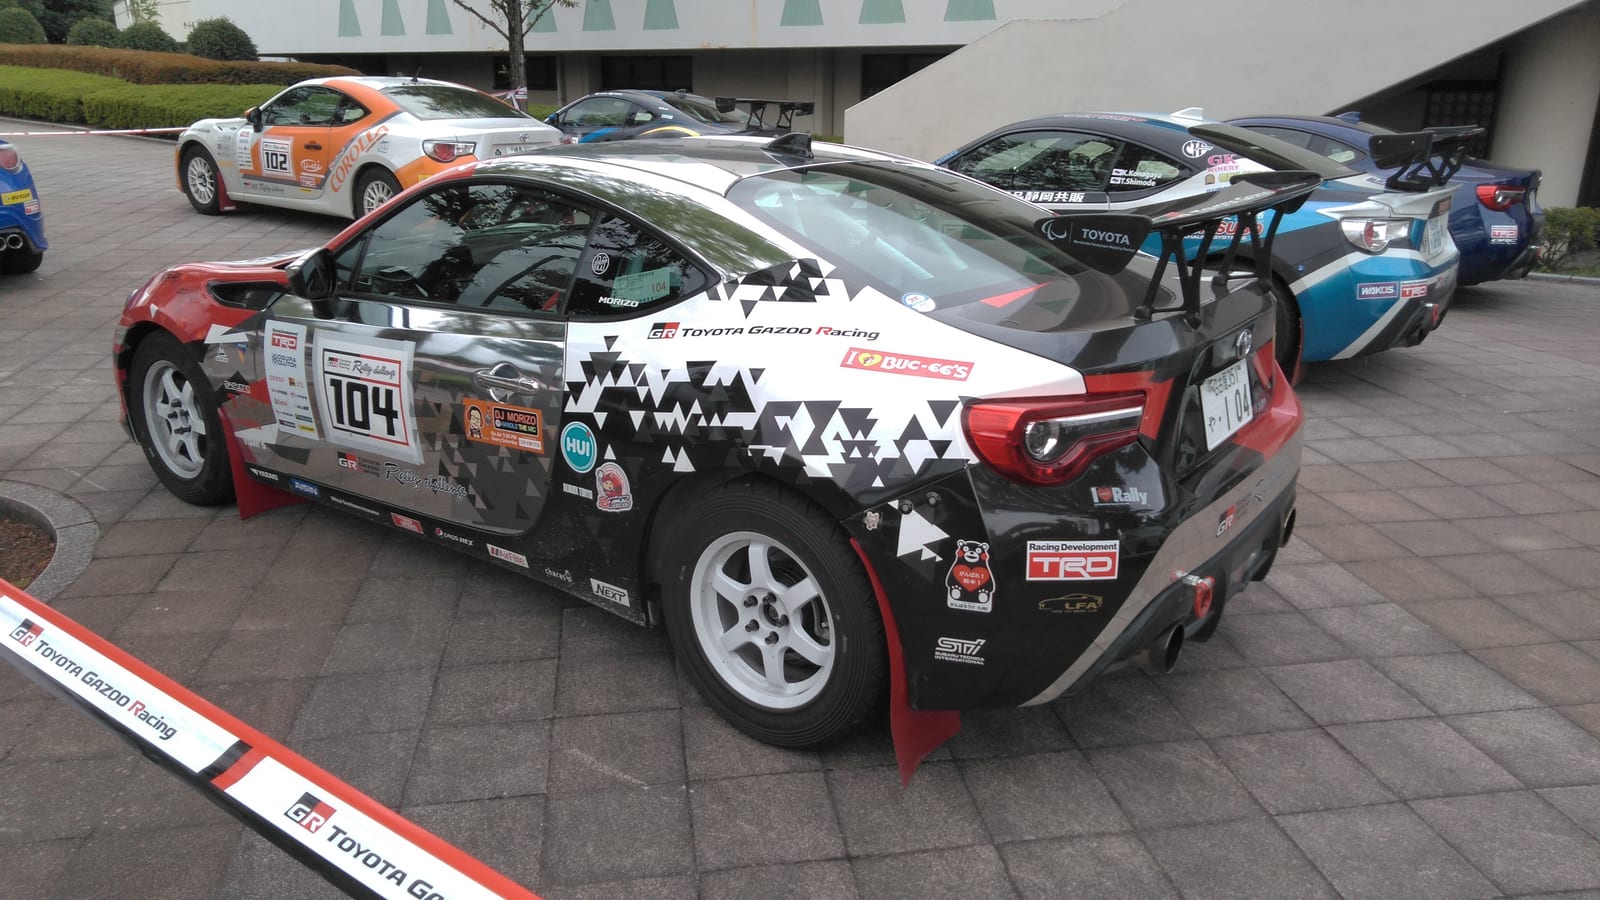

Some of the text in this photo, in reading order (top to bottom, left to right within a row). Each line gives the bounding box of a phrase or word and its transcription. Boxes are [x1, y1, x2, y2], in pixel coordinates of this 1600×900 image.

[265, 151, 288, 171] 102
[330, 124, 390, 193] COROLLA
[1081, 228, 1130, 245] TOYOTA
[598, 296, 639, 308] MORIZO
[648, 325, 880, 341] GR TOYOTA GAZOO Racing
[330, 378, 398, 437] 104
[495, 410, 537, 425] DJ MORIZO
[566, 436, 590, 457] HUI
[338, 456, 357, 470] GR
[1111, 487, 1147, 505] Rally
[1061, 543, 1117, 551] Development
[1033, 557, 1113, 578] TRD
[596, 583, 626, 602] NEXT
[35, 640, 83, 677] TOYOTA
[81, 671, 130, 707] GAZOO
[128, 700, 177, 741] Racing
[327, 825, 408, 887] TOYOTA
